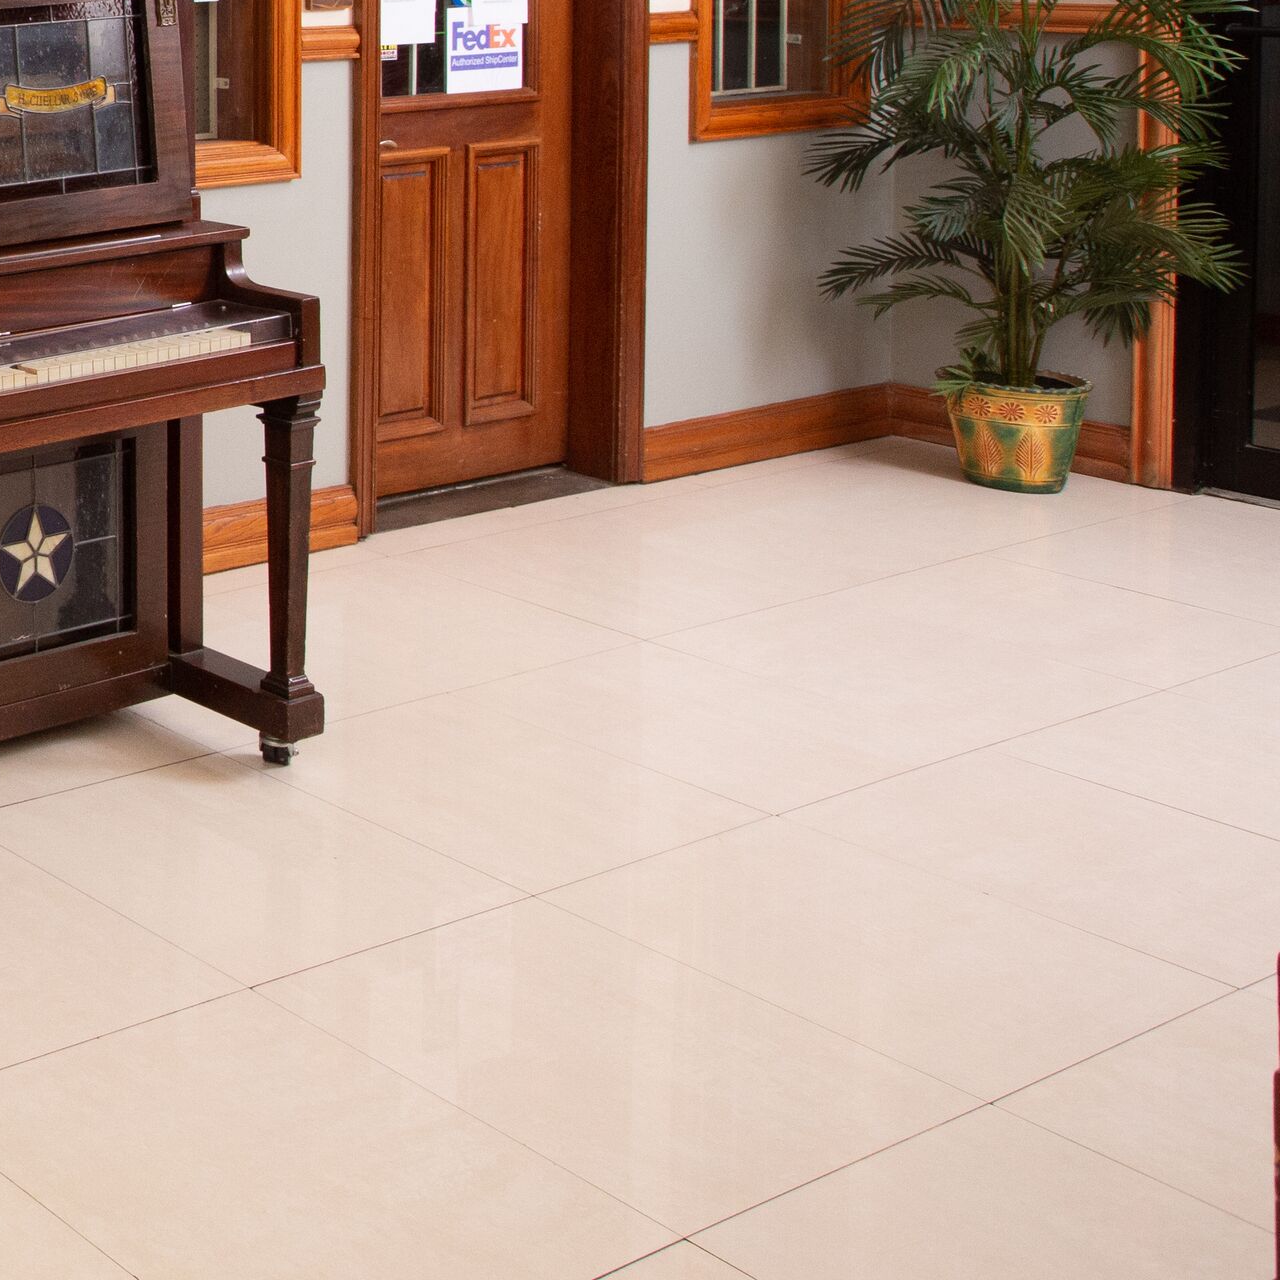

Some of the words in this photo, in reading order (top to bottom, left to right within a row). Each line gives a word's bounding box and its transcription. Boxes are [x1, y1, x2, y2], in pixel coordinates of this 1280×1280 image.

[452, 21, 516, 51] FedEx
[452, 56, 484, 67] Authorized
[485, 54, 518, 66] ShipCenter
